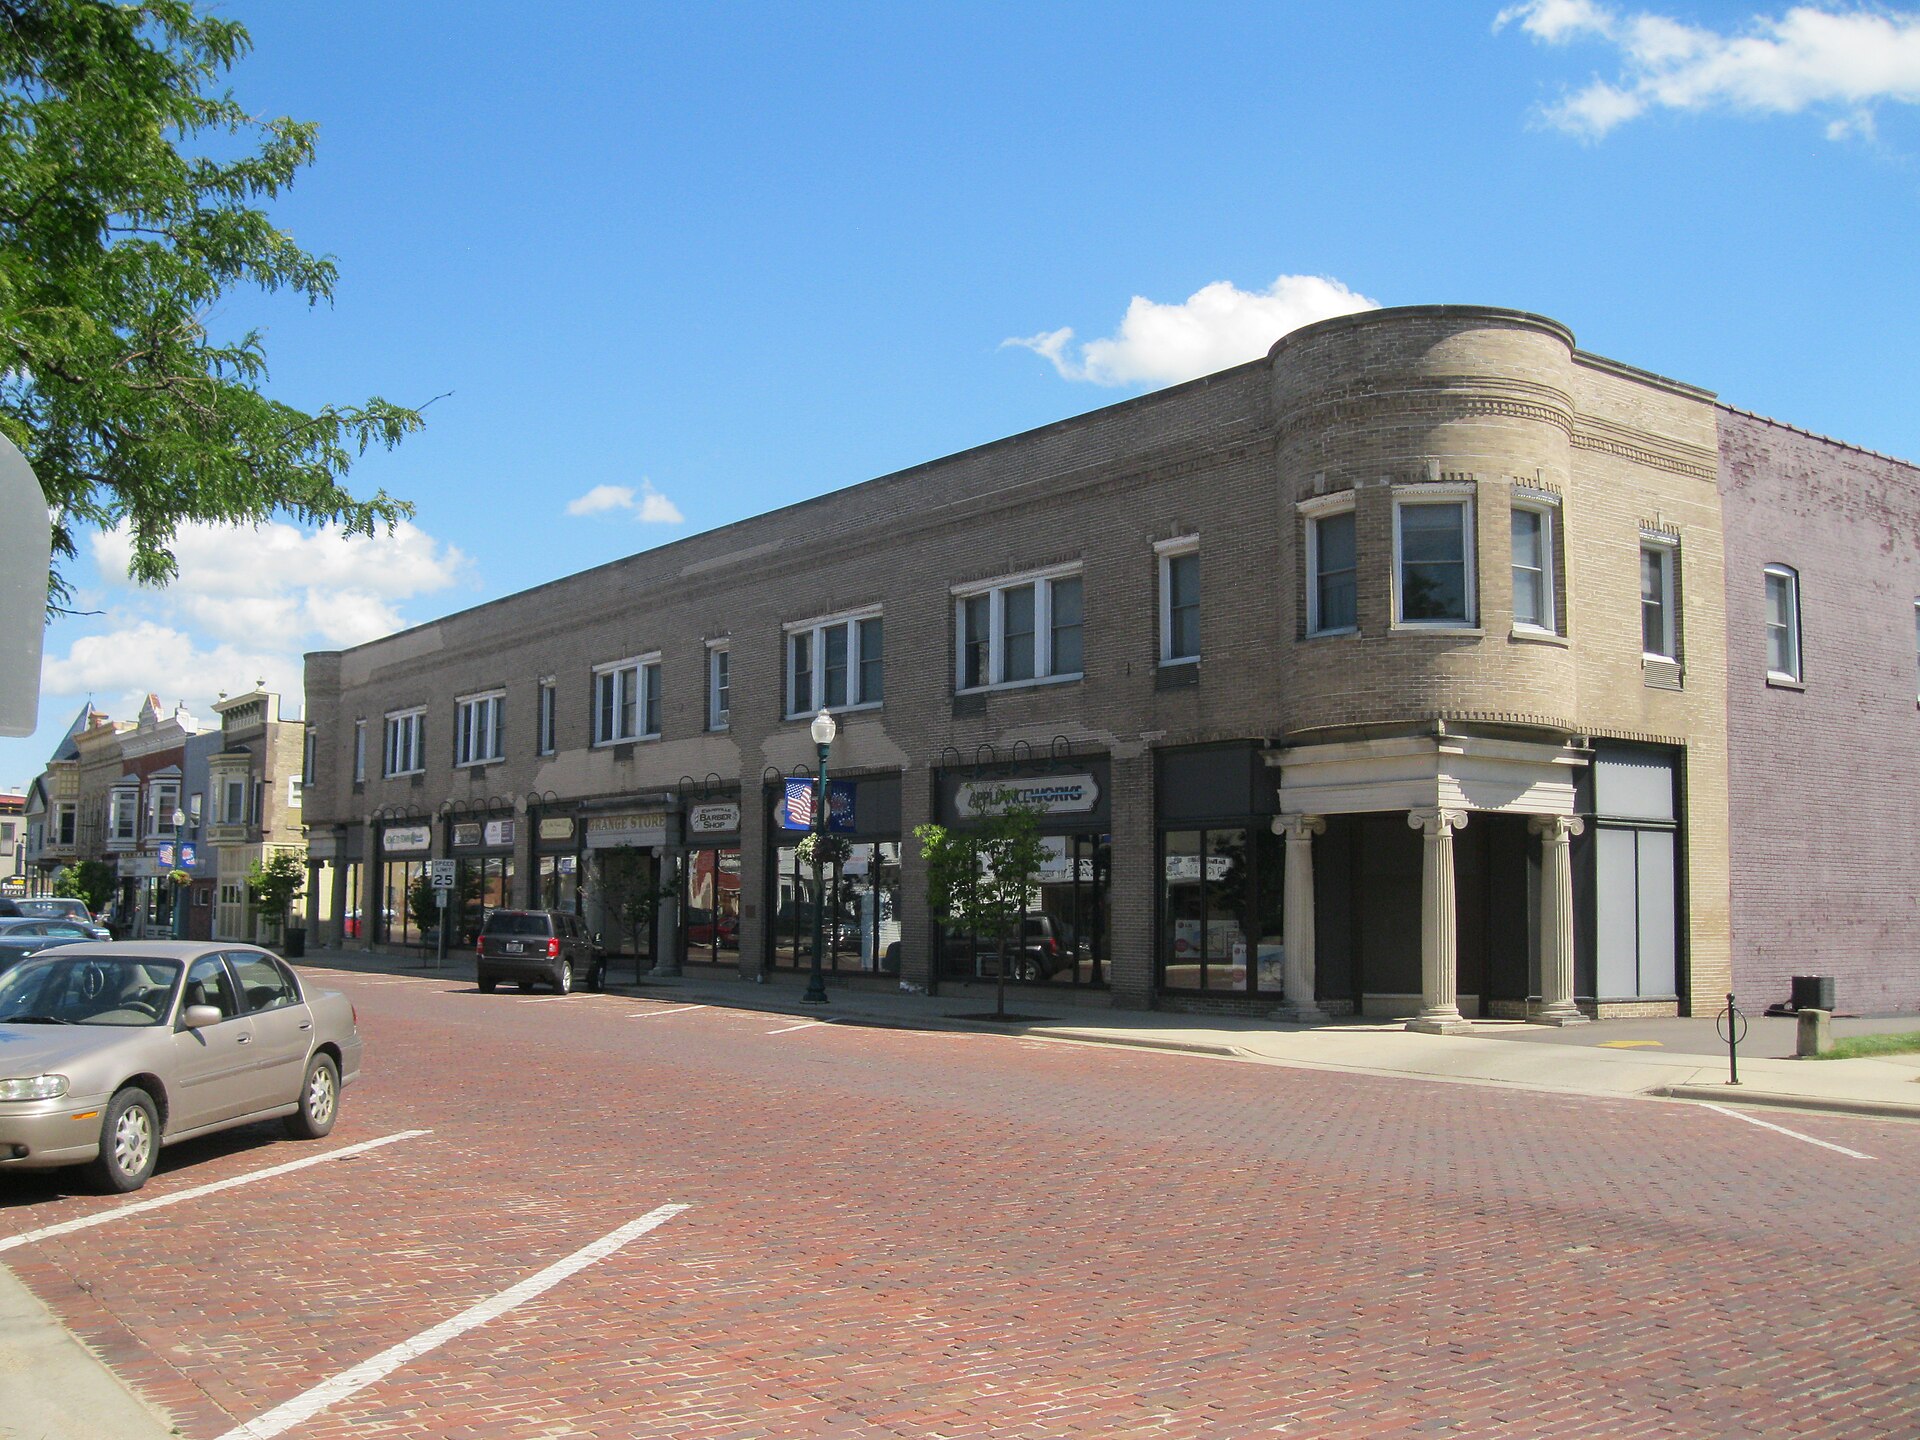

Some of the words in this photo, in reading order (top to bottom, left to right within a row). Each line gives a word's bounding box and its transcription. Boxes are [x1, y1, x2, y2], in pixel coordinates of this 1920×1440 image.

[967, 784, 1084, 808] APPLINCEWORKS
[589, 816, 625, 831] GRANGE
[631, 812, 665, 828] STORE
[700, 813, 732, 822] BARBER
[703, 820, 725, 829] SHOP
[433, 874, 453, 886] 25
